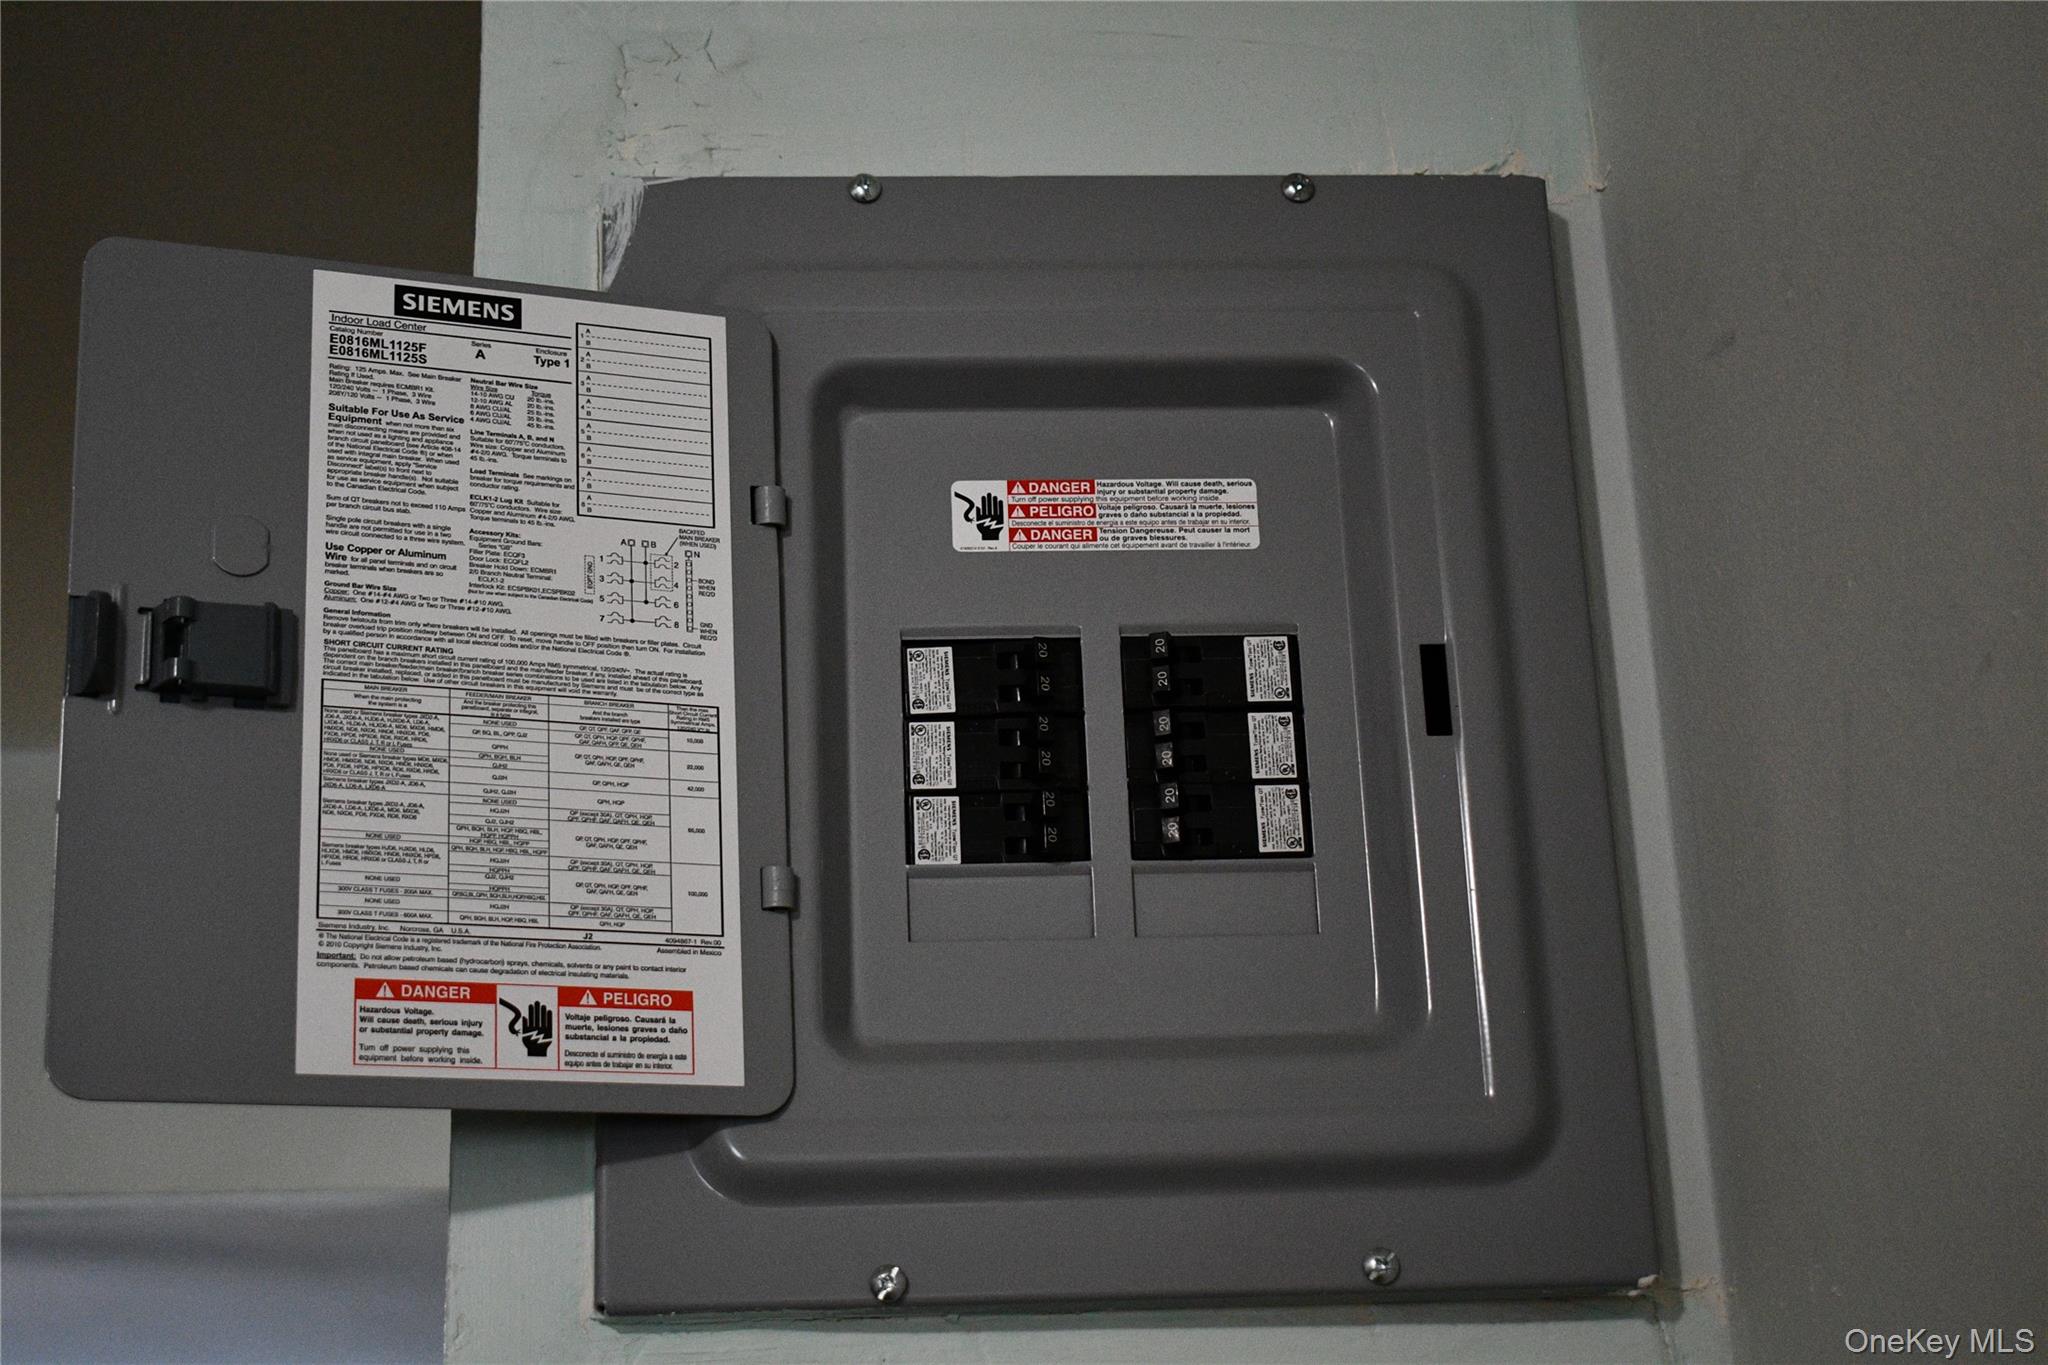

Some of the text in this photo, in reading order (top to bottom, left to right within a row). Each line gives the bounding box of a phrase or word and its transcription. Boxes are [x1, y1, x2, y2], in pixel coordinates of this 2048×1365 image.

[403, 294, 514, 320] SIEMENS
[331, 314, 428, 331] Indoor Load Center
[329, 333, 427, 352] E0816ML1125F
[329, 344, 427, 364] E0816ML1125S
[475, 349, 485, 359] A
[534, 356, 569, 367] Type 1
[328, 403, 464, 423] Suitable For Use As Service
[328, 413, 381, 426] Equipment
[1029, 482, 1090, 492] DANGER
[1030, 505, 1094, 517] PELIGRO
[1031, 529, 1092, 540] DANGER
[1130, 526, 1176, 534] Dangereuse.
[325, 542, 344, 554] Use
[347, 544, 382, 554] Copper
[398, 548, 446, 559] Aluminum
[325, 552, 347, 562] Wire
[1038, 642, 1048, 658] 20
[1155, 638, 1165, 653] 20
[1040, 676, 1050, 691] 20
[1157, 671, 1168, 686] 20
[1039, 716, 1049, 731] 20
[1159, 716, 1169, 731] 20
[1041, 751, 1052, 766] 20
[1162, 750, 1173, 766] 20
[1046, 792, 1055, 807] 20
[1165, 788, 1175, 803] 20
[1048, 828, 1057, 842] 20
[1168, 822, 1179, 838] 20
[402, 985, 470, 998] DANGER
[604, 992, 672, 1006] PELIGRO
[404, 1008, 433, 1016] Voltage.
[565, 1013, 590, 1022] Voltaje
[451, 1029, 483, 1037] damage.
[419, 1046, 453, 1054] supplying
[428, 1056, 455, 1064] working
